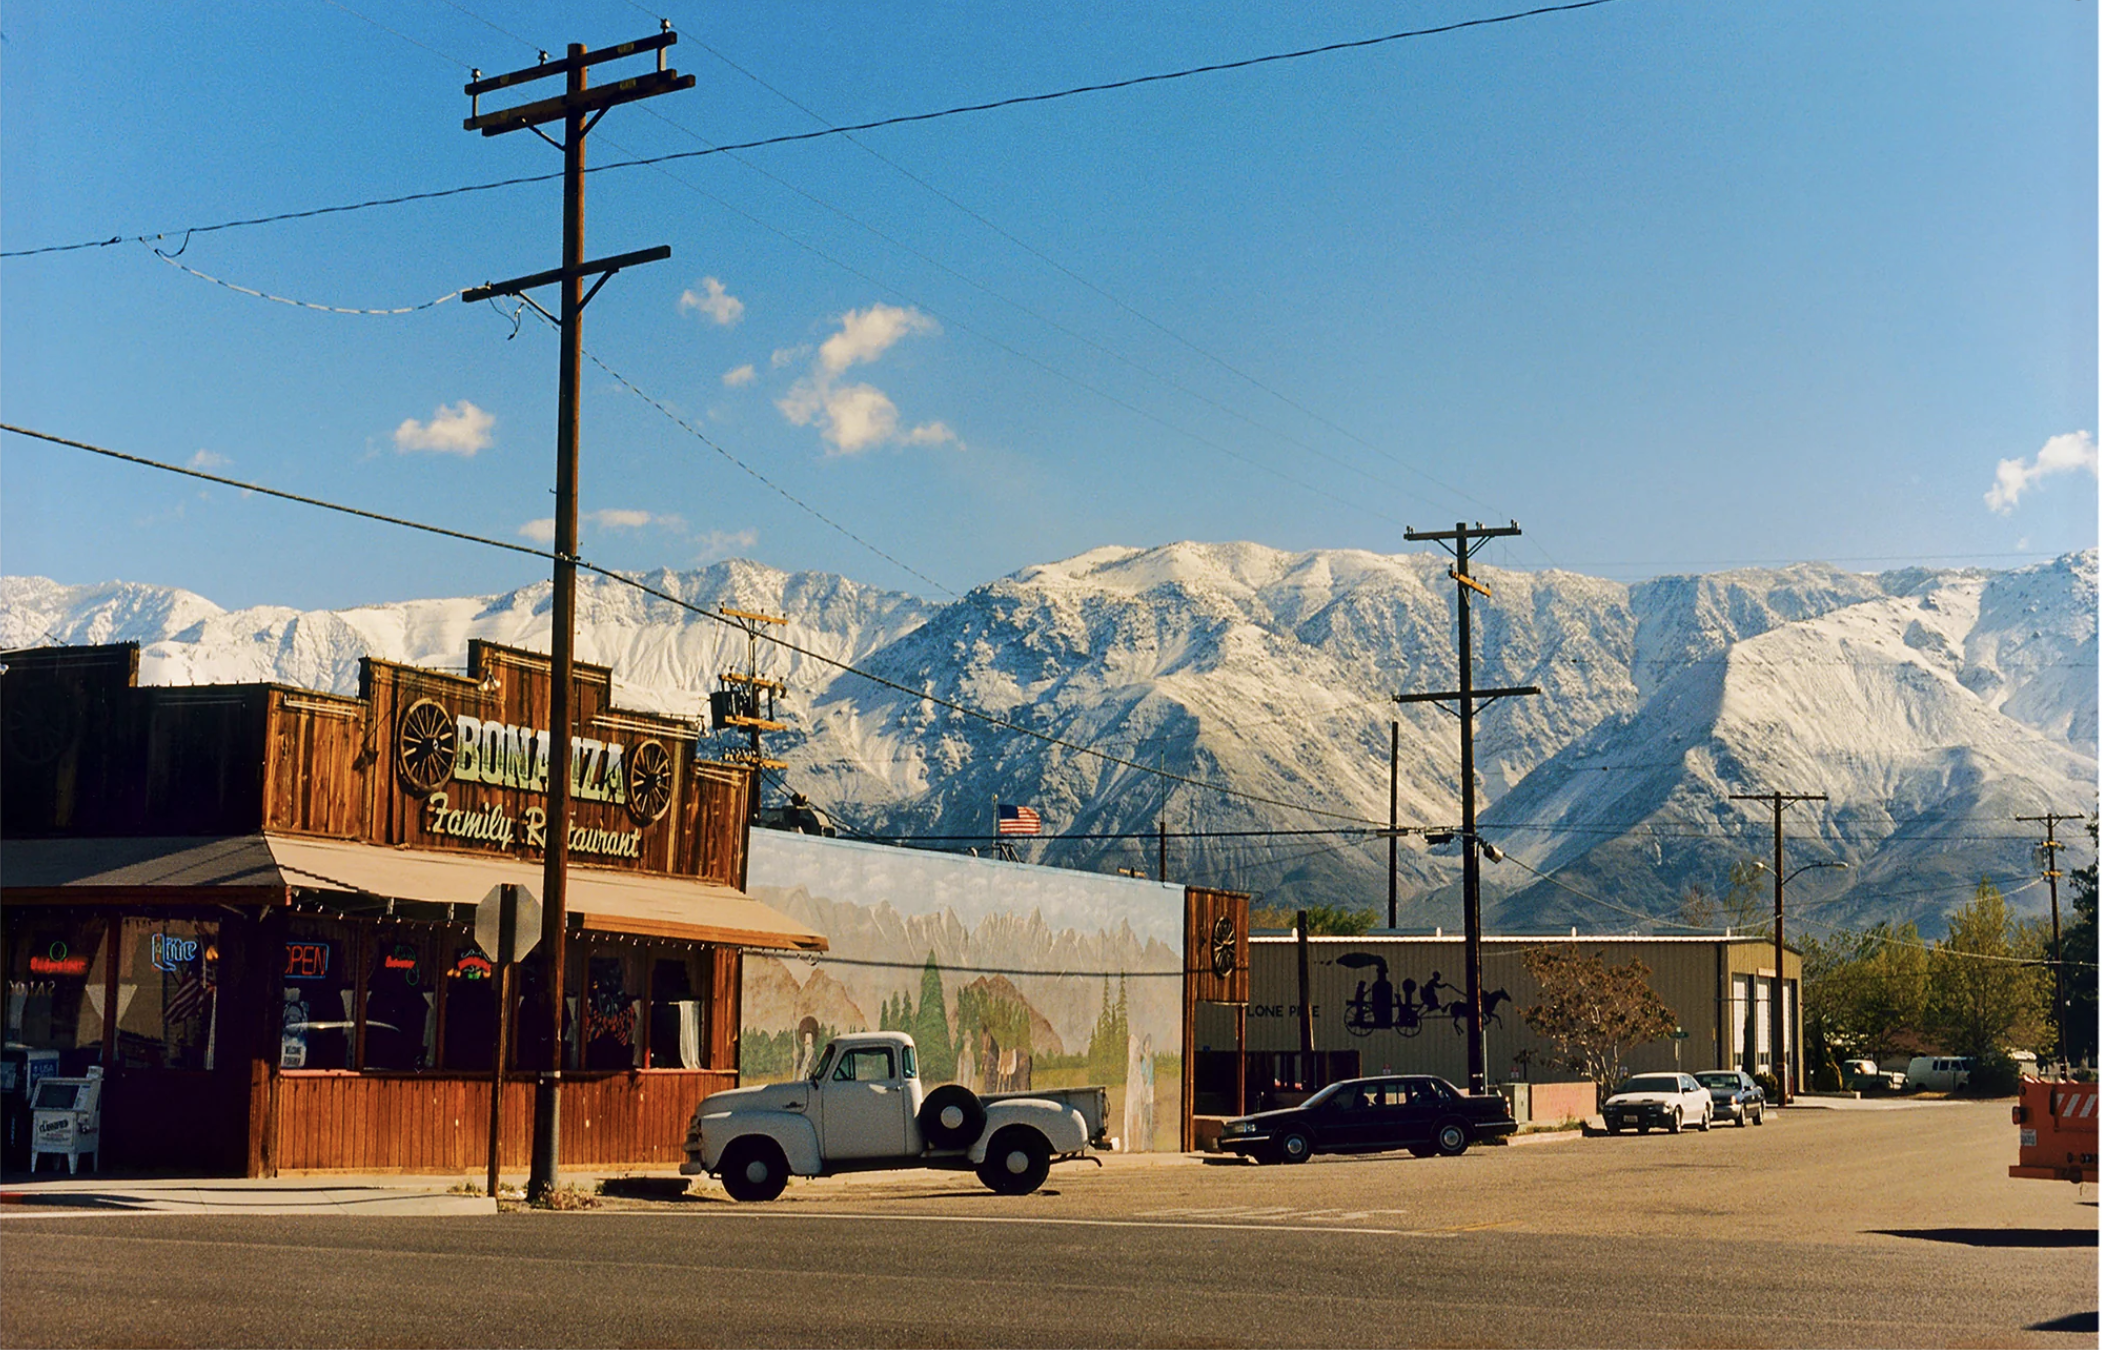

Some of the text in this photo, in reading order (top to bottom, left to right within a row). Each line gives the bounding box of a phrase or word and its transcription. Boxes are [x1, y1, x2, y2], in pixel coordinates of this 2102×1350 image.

[426, 791, 640, 857] Family Rtaurant
[151, 932, 198, 972] Lite
[1247, 1004, 1320, 1017] LONE PIE
